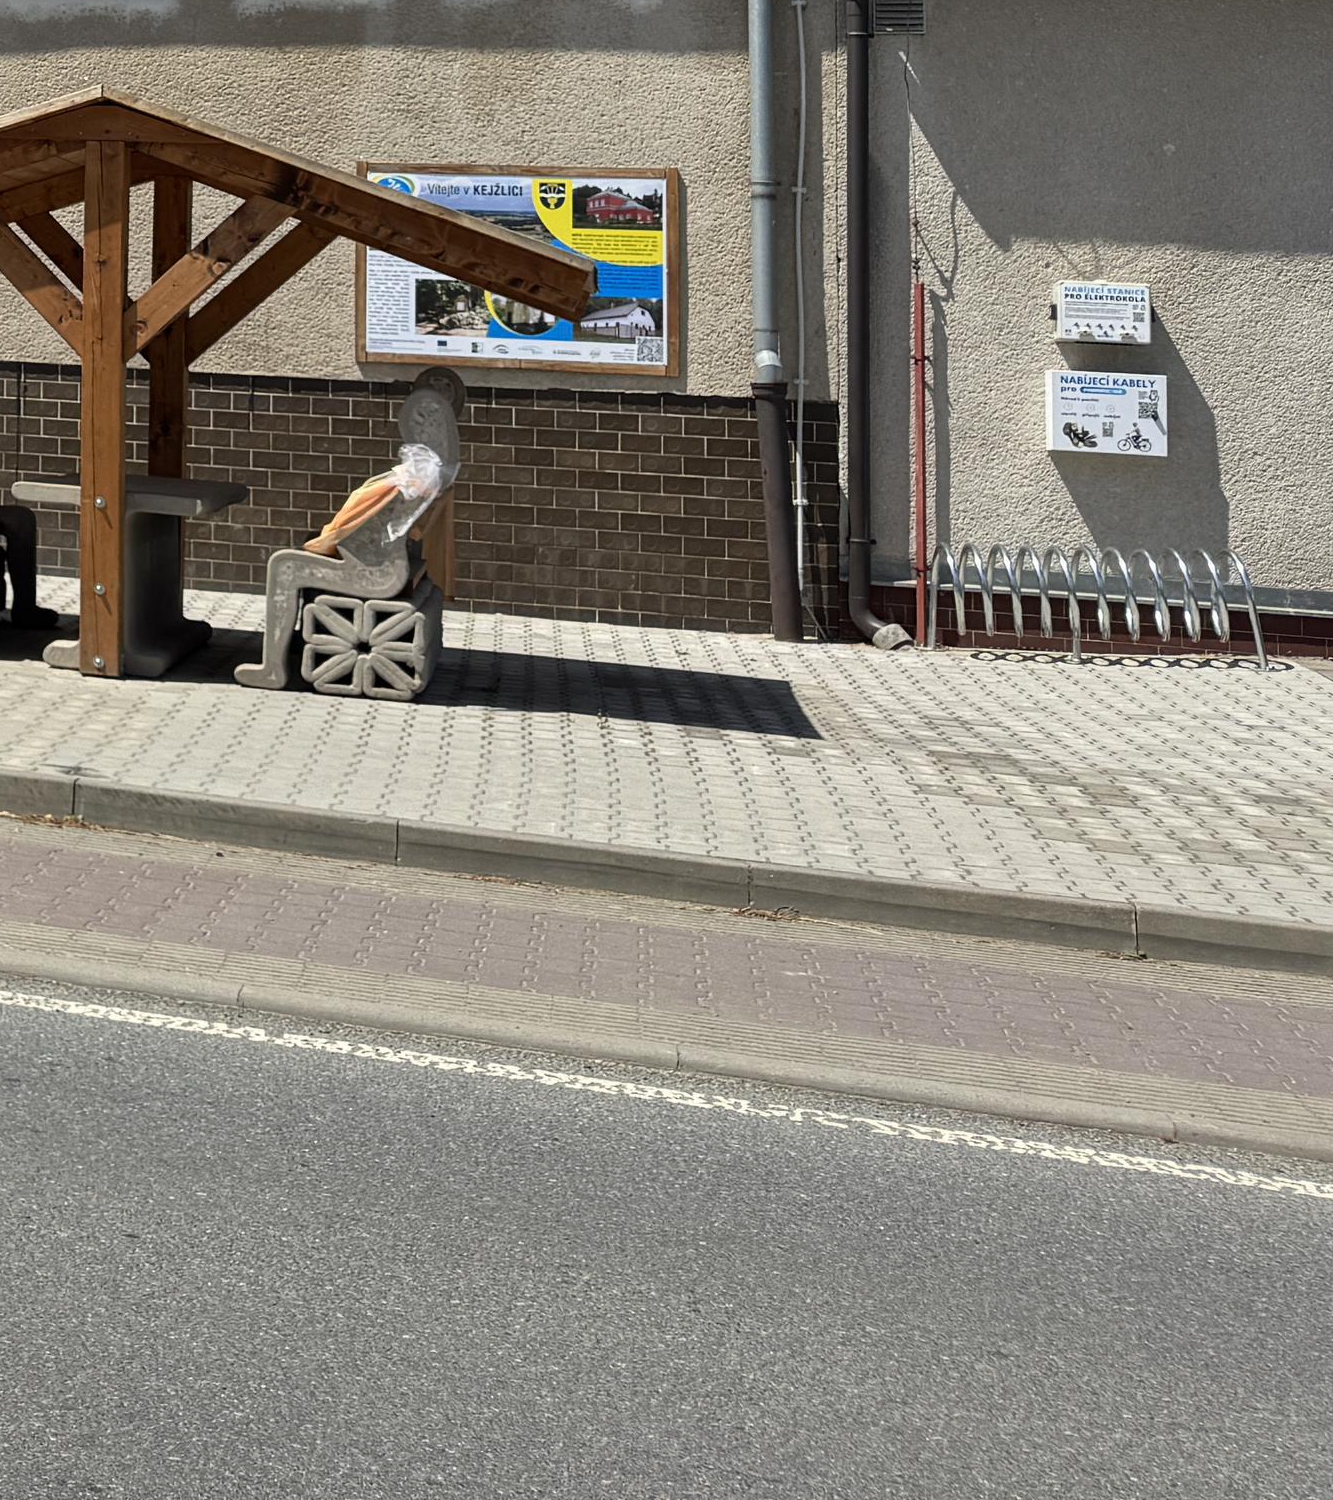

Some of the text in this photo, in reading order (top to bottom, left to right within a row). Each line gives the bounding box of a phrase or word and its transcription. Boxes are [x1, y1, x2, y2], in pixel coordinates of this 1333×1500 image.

[463, 186, 470, 195] v
[473, 183, 523, 197] KEJŽLICI
[1064, 285, 1145, 296] NABÍJECÍ STANICE
[1084, 294, 1146, 303] ELEKTROKOLA
[1061, 374, 1156, 389] NABÍJECÍ KABELY
